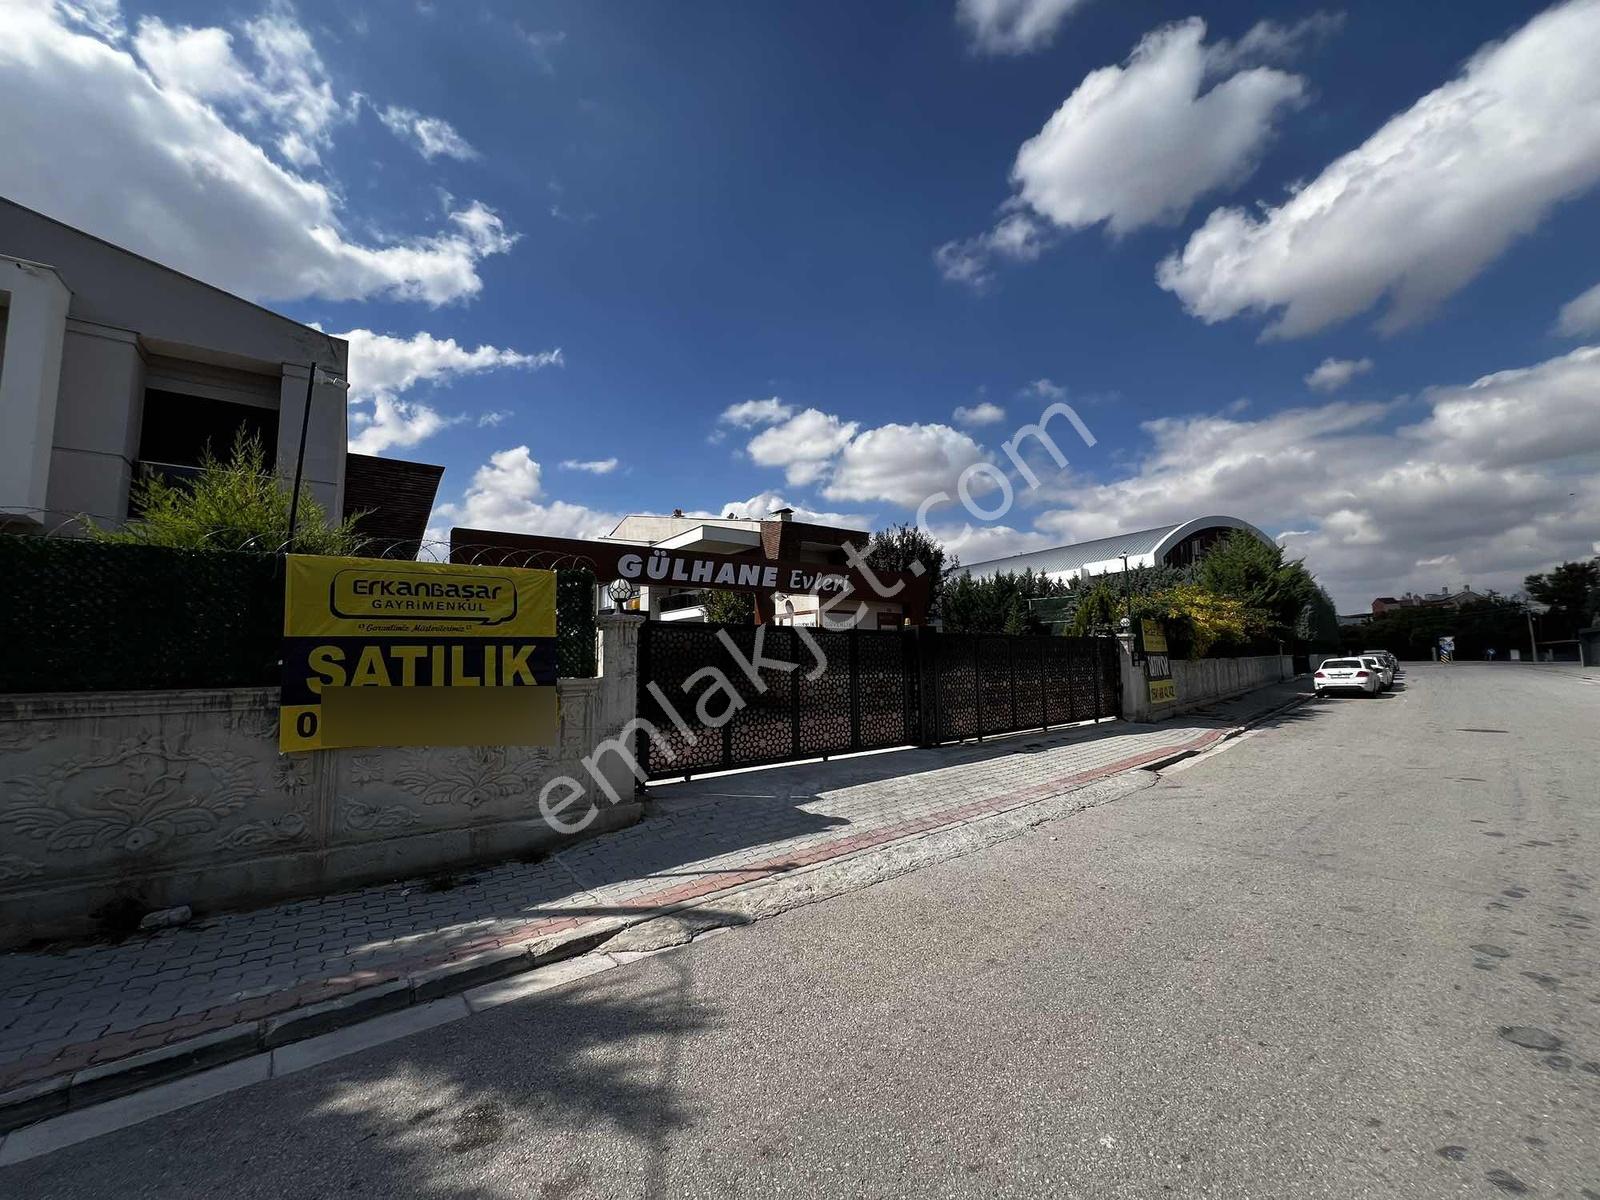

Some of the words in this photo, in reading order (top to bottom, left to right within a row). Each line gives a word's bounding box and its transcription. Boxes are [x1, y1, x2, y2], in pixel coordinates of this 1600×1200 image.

[617, 550, 779, 588] GÜLHANE
[789, 569, 851, 593] Evleri
[306, 645, 538, 695] SATILIK
